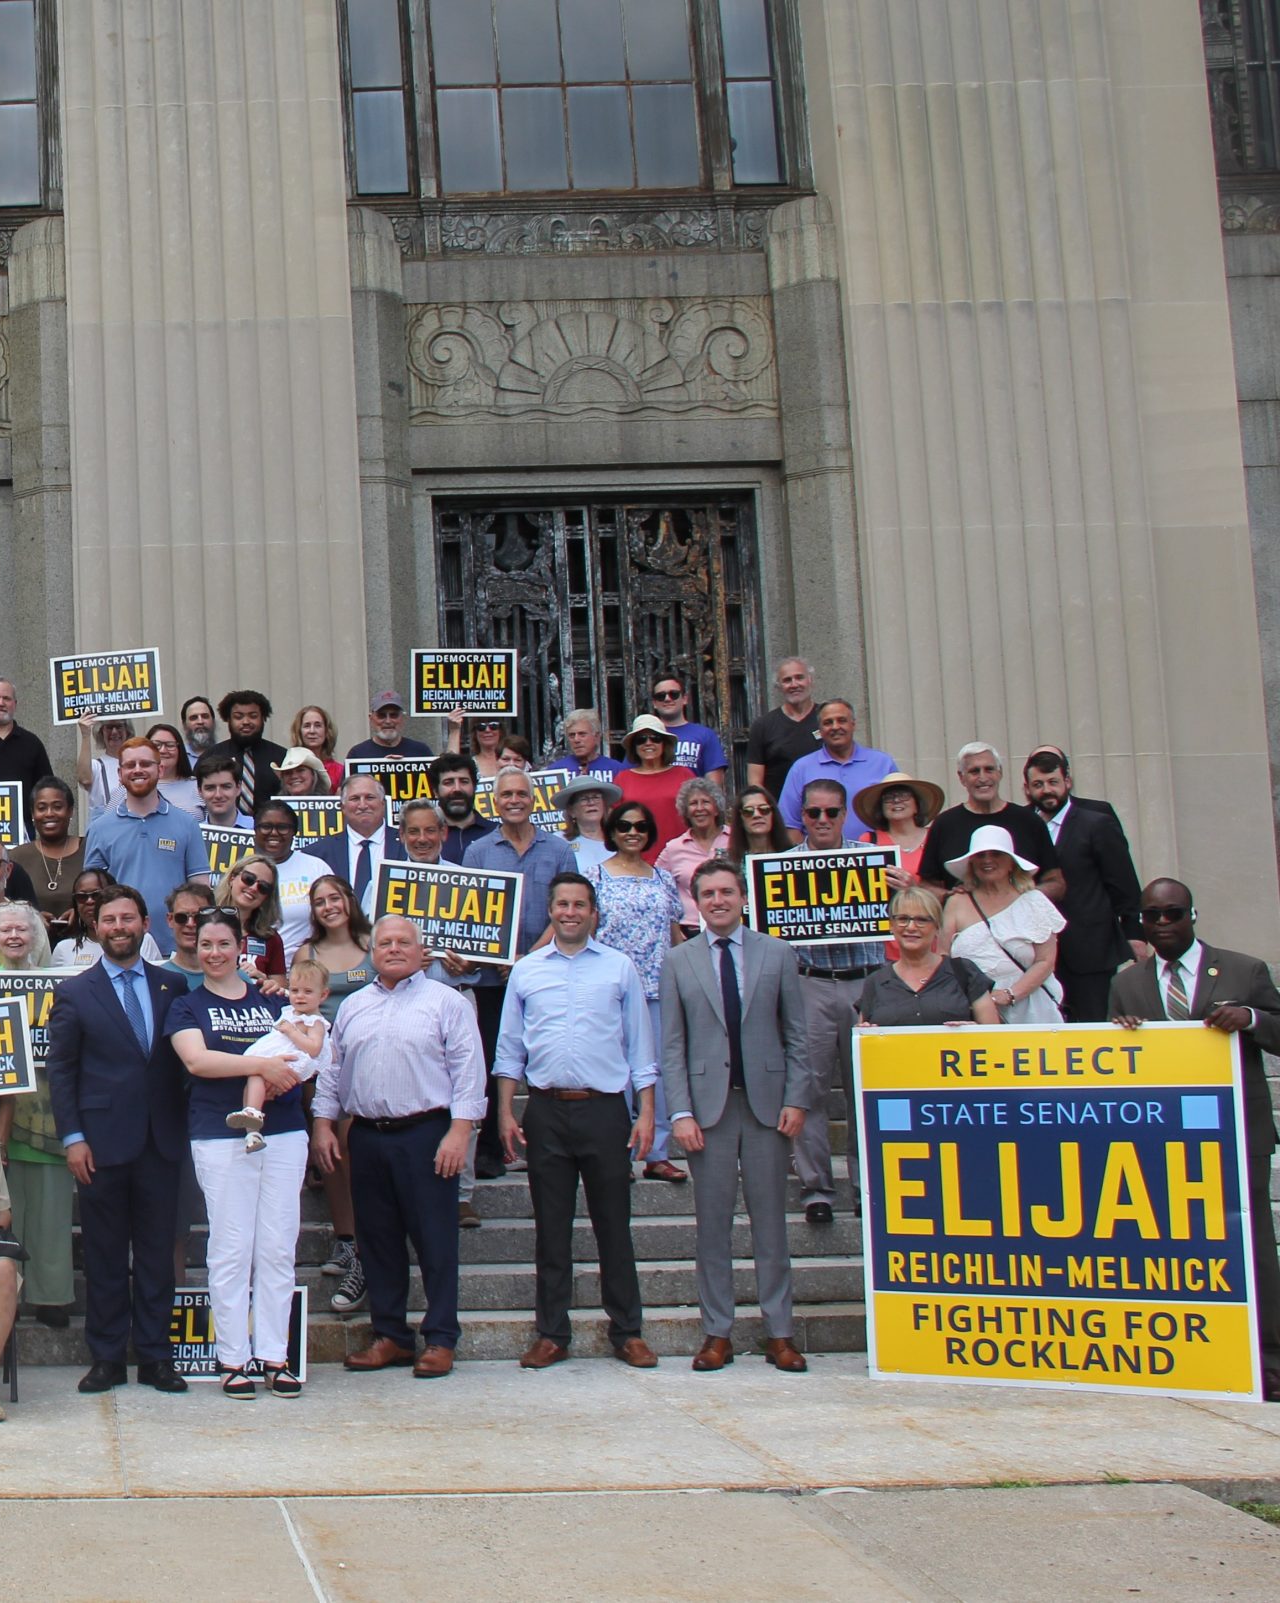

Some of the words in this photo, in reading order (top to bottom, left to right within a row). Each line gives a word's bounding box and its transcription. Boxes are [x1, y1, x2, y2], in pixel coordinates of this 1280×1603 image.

[75, 656, 133, 668] DEMOCRAT
[436, 654, 492, 662] DEMOCRAT
[62, 664, 150, 696] ELIJAH
[423, 664, 506, 688] ELIJAH
[64, 689, 150, 707] REICHLIN-MELNICK
[423, 690, 505, 700] REICHLIN-MELNICK
[74, 706, 102, 716] STATE
[104, 702, 141, 712] SENATE
[432, 702, 460, 710] STATE
[462, 702, 496, 710] SENATE
[300, 802, 341, 810] DEMOC
[782, 856, 865, 872] DEMOCRAT
[408, 870, 487, 888] DEMOCRAT
[764, 868, 890, 909] ELIJAH
[386, 880, 505, 924] ELIJAH
[767, 904, 889, 925] REICHLIN-MELNICK
[781, 923, 822, 937] STATE
[825, 921, 877, 935] SENATE
[437, 936, 487, 952] SENATE
[208, 1006, 273, 1020] ELIJAH
[940, 1046, 1143, 1078] RE-ELECT
[920, 1102, 1008, 1126] STATE
[1020, 1101, 1165, 1125] SENATOR
[881, 1141, 1227, 1241] ELIJAH
[887, 1250, 1232, 1293] REICHLIN-MELNICK
[912, 1303, 1108, 1339] FIGHTING
[1125, 1311, 1211, 1344] FOR
[946, 1337, 1175, 1376] ROCKLAND
[174, 1361, 216, 1372] STATE
